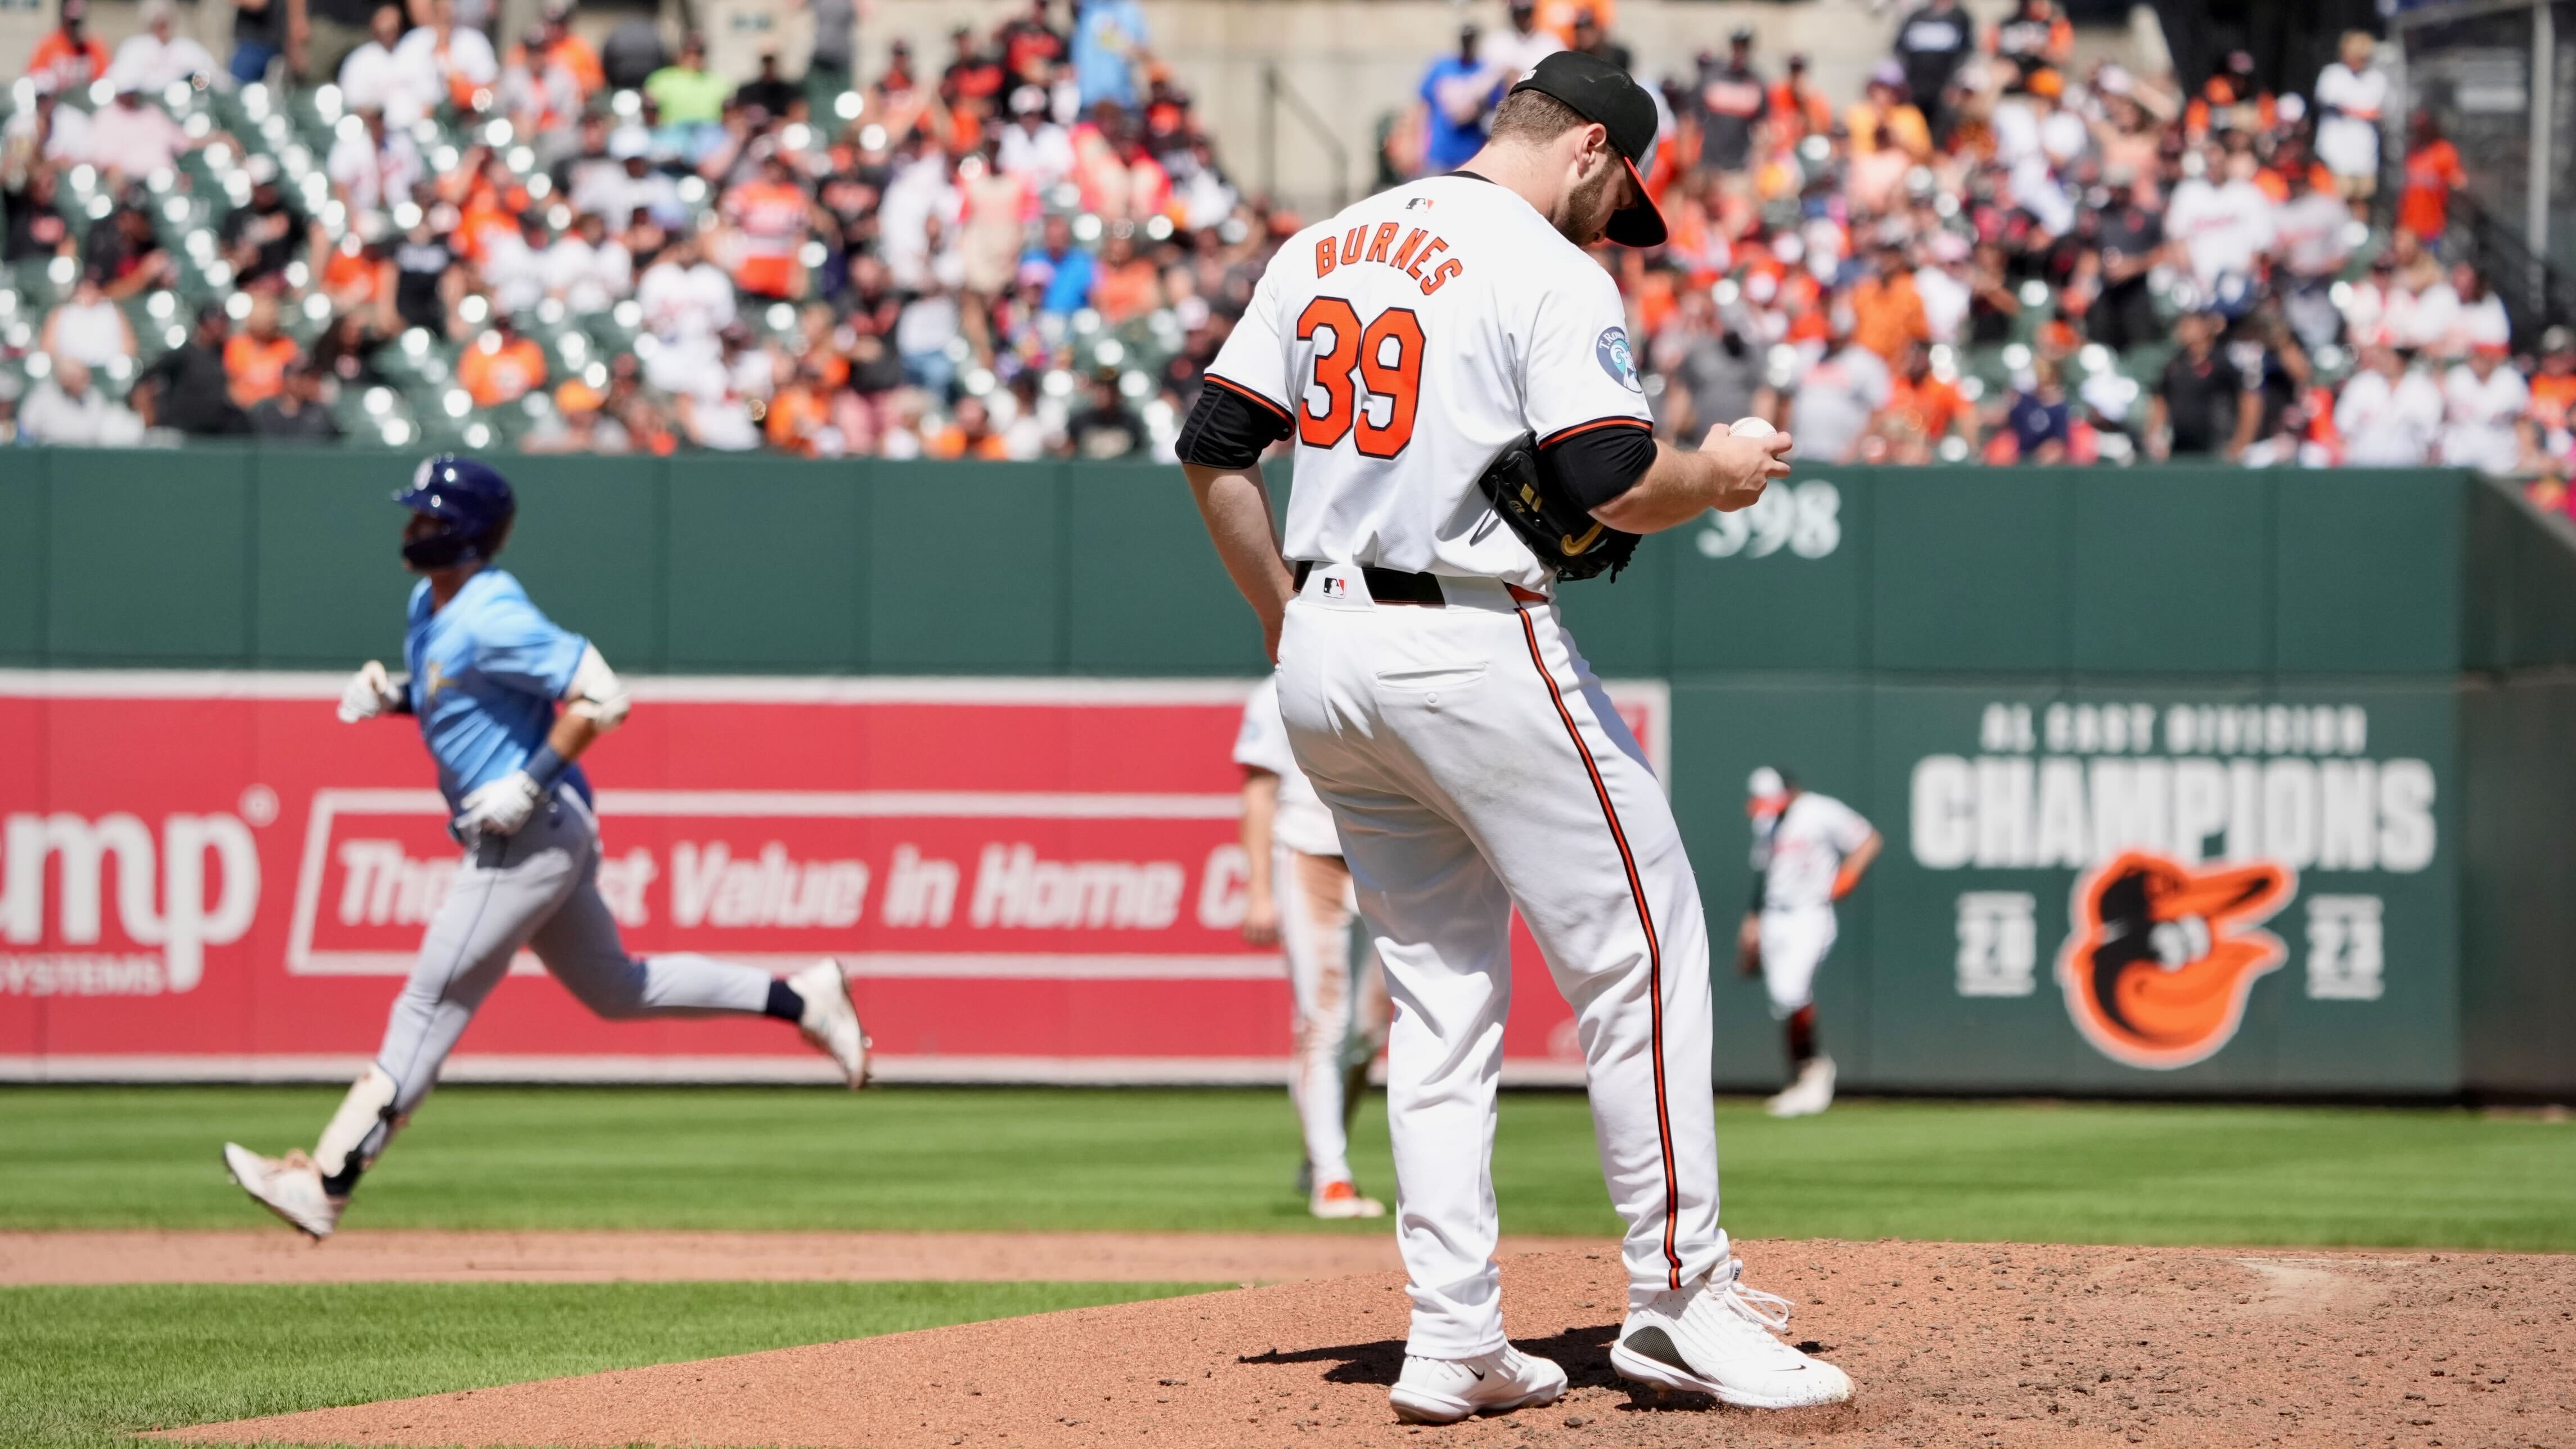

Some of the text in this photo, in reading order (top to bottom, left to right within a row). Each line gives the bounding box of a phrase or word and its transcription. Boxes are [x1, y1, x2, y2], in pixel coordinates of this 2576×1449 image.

[1316, 222, 1462, 295] BURNES
[1296, 295, 1426, 460] 39
[1980, 703, 2367, 755] AL EAST DIVISION
[1911, 754, 2436, 872] CHAMPIONS
[0, 812, 262, 994] mp
[595, 847, 659, 927] st
[670, 840, 870, 928] Value
[969, 843, 1185, 929] Home
[0, 953, 165, 996] YSTEMS
[1732, 1267, 1741, 1281] NIKE
